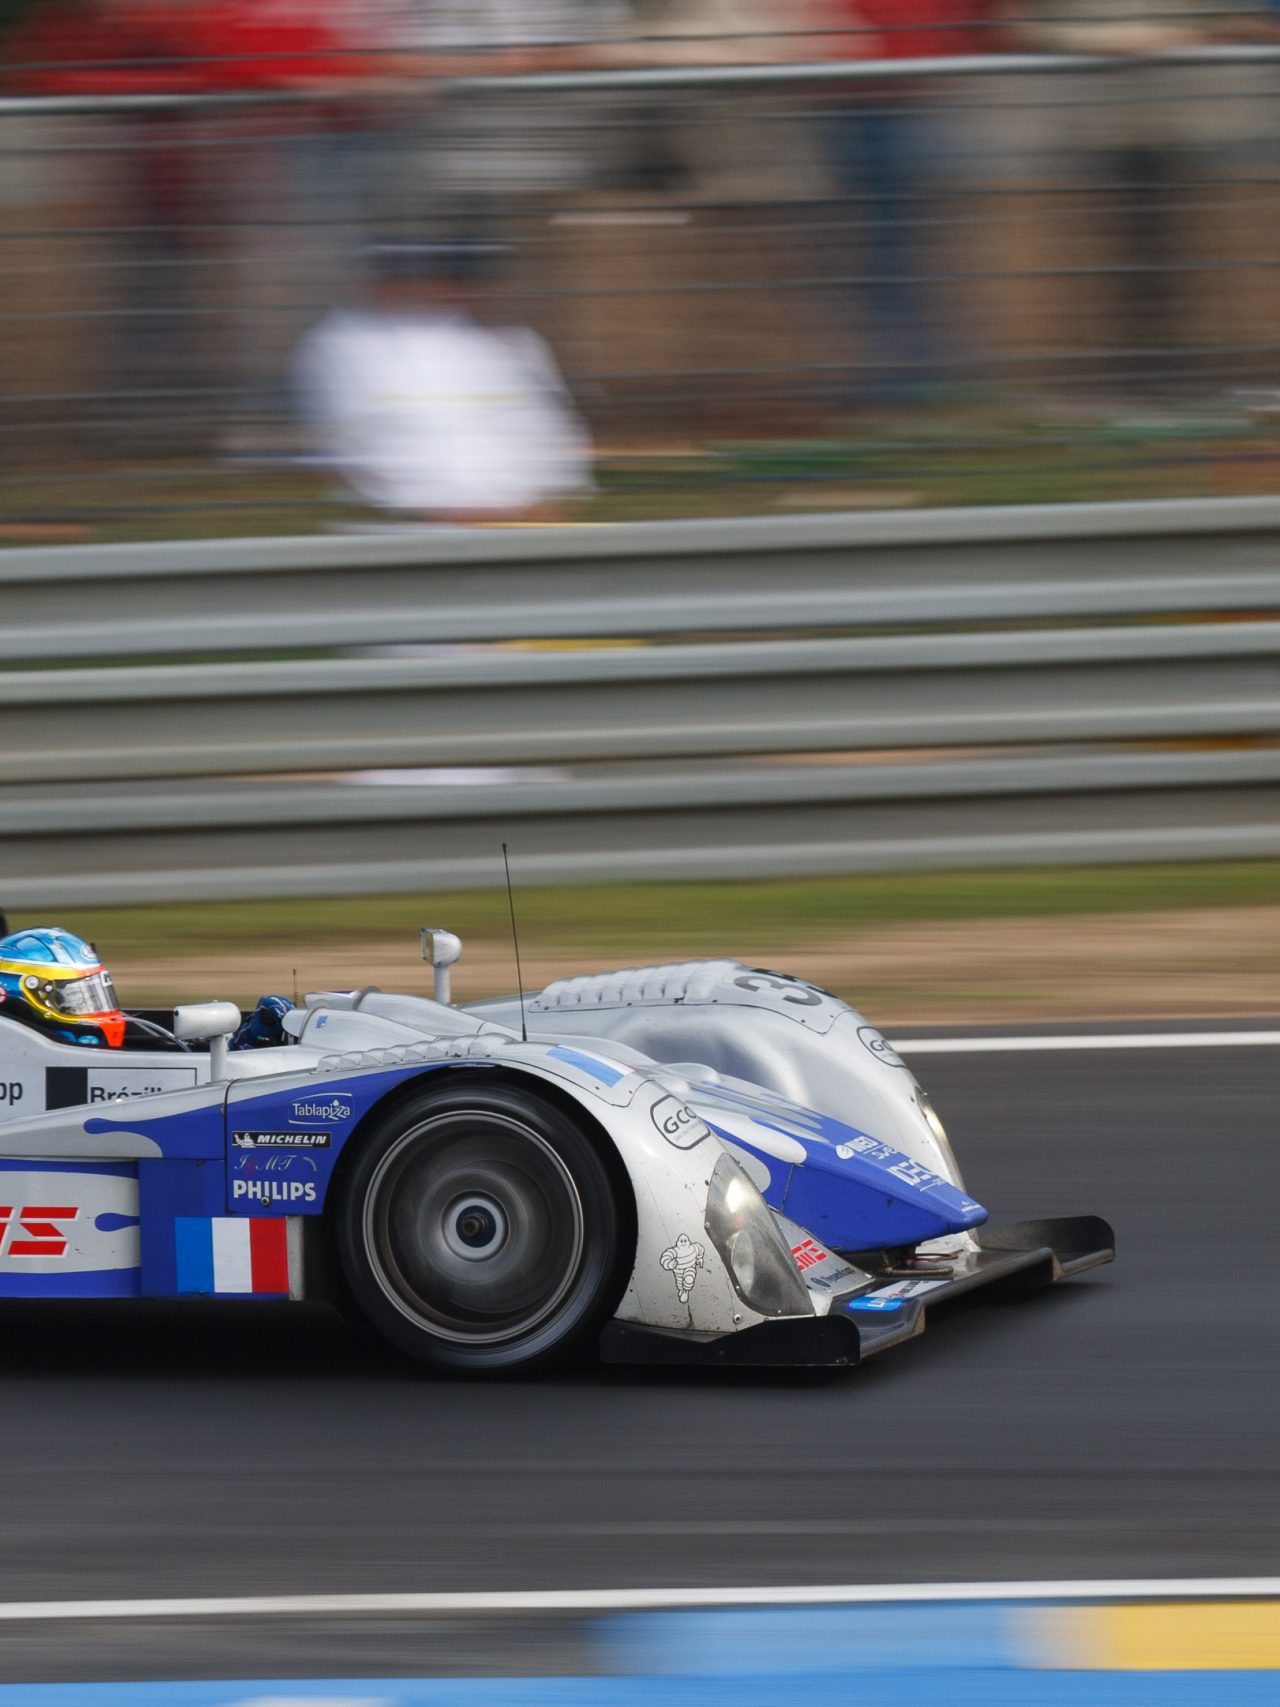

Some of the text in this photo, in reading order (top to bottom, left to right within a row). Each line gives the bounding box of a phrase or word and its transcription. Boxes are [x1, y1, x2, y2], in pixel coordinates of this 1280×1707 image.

[292, 1099, 351, 1121] Tablapizza
[663, 1106, 697, 1134] GCC
[257, 1134, 327, 1145] MICHELIN
[233, 1179, 317, 1201] PHILIPS
